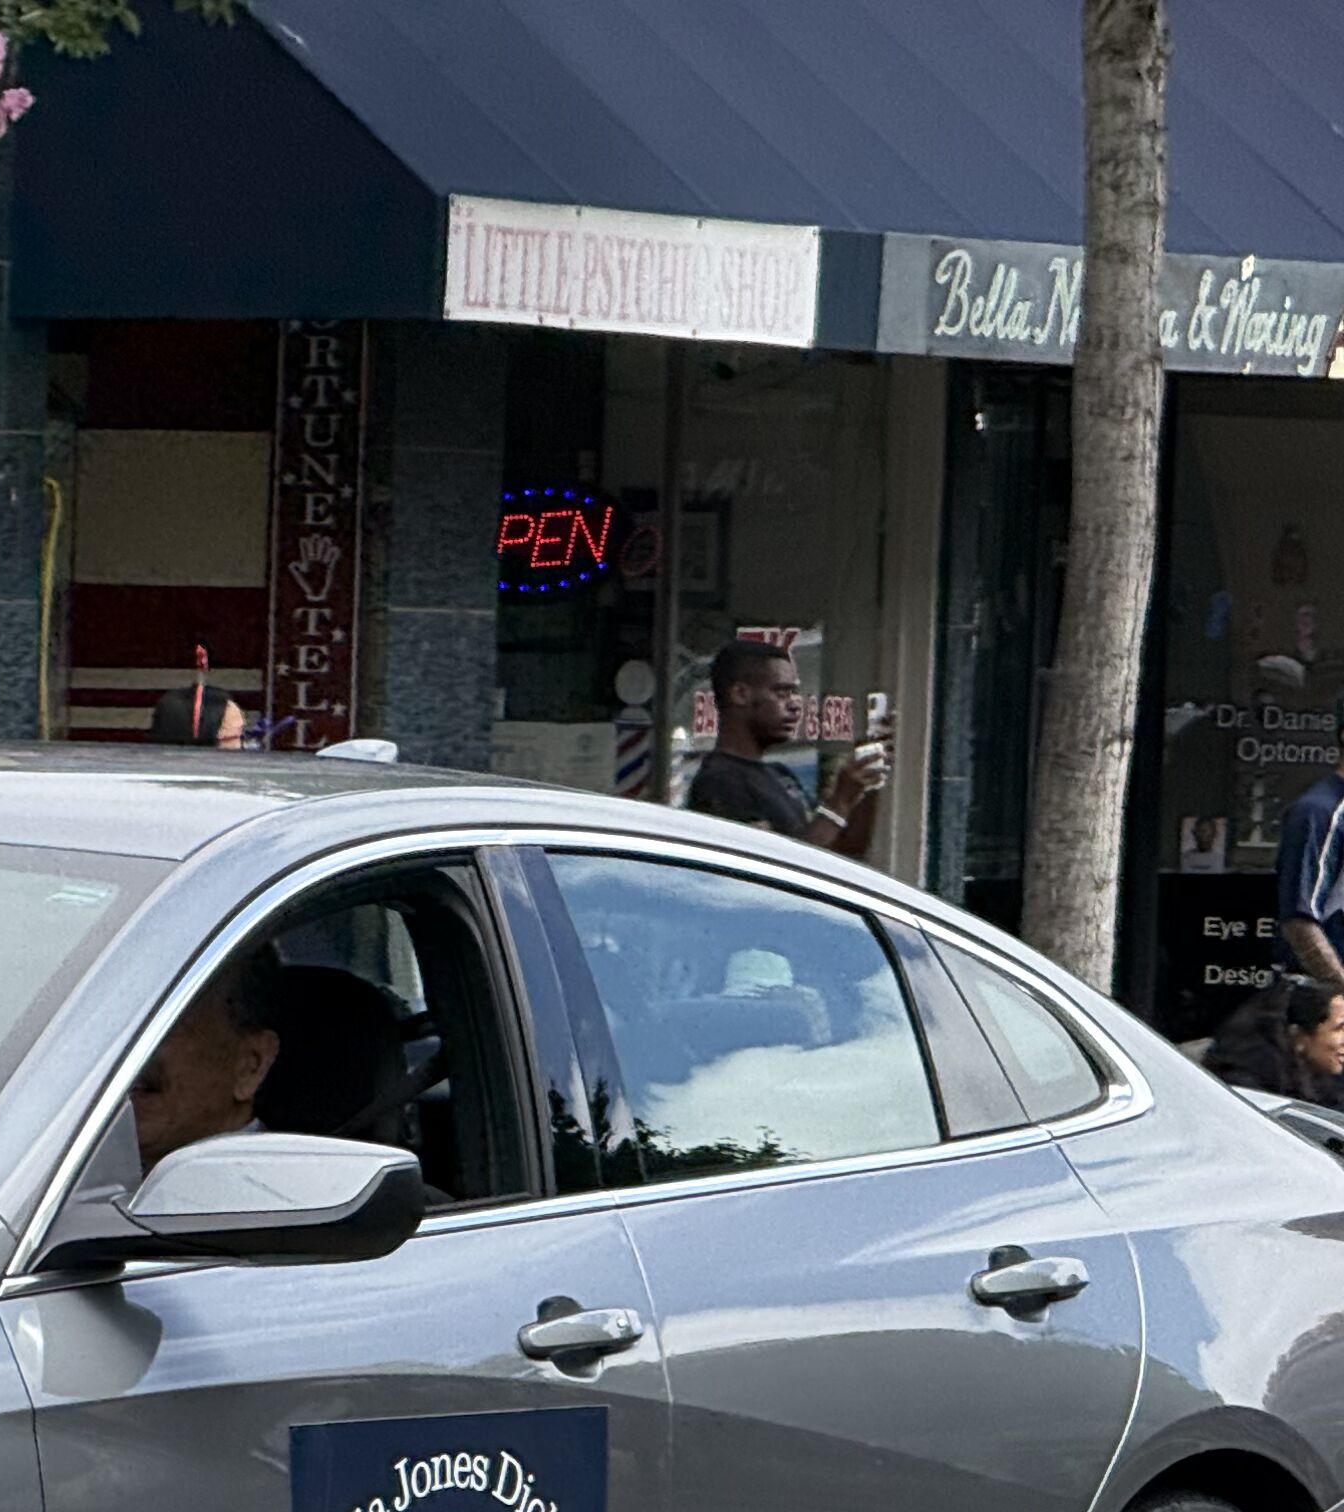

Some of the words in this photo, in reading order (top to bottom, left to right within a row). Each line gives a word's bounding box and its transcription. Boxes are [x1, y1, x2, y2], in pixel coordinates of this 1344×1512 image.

[464, 222, 571, 315] LITTLE
[935, 248, 1033, 342] Bella
[298, 320, 342, 527] RTUNE
[1203, 916, 1247, 941] Eye
[394, 1451, 491, 1512] Jones
